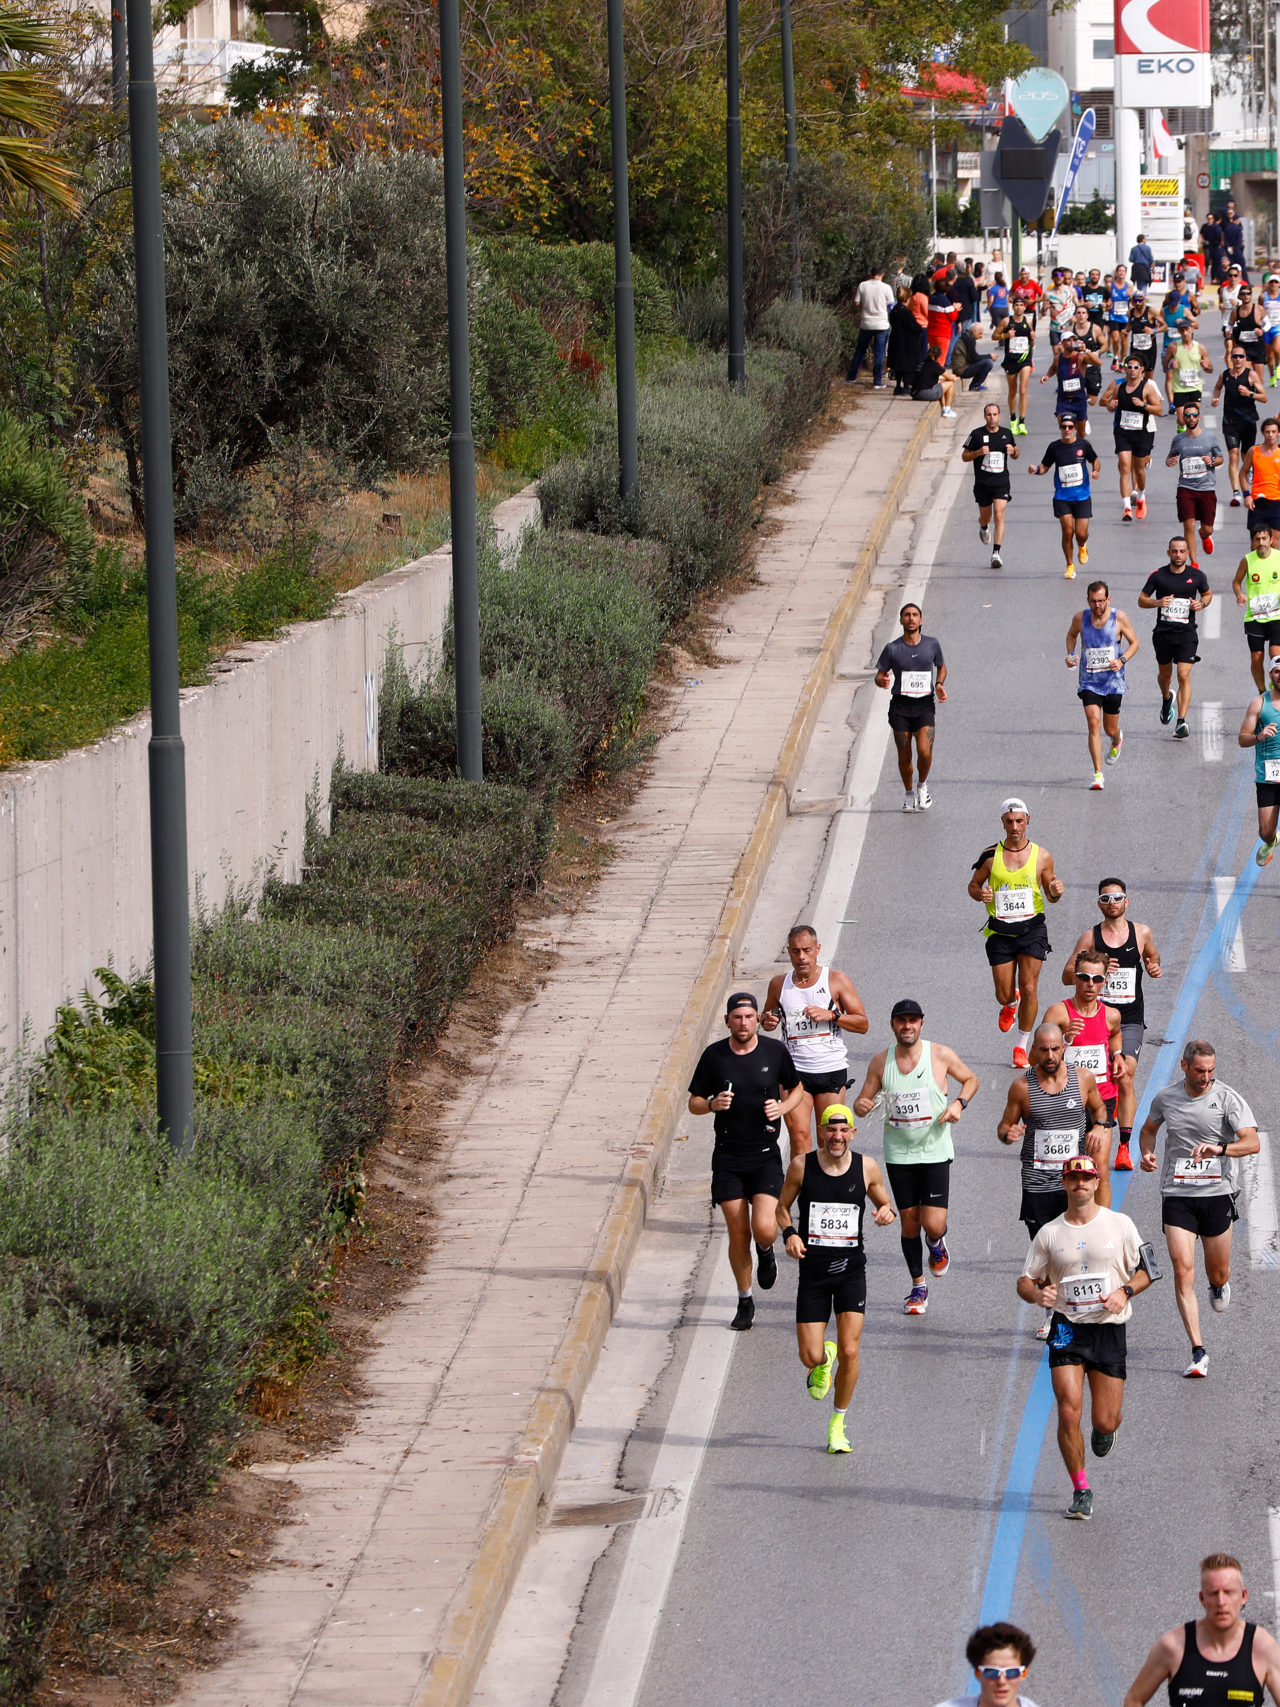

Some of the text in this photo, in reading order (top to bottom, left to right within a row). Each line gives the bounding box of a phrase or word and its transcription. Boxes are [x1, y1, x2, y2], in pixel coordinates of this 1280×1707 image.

[1137, 58, 1195, 74] EKO
[1003, 902, 1025, 911] 3644
[1105, 981, 1128, 990] 1453
[895, 1103, 920, 1114] 3391
[1043, 1144, 1071, 1155] 3686
[1184, 1159, 1211, 1170] 2417
[820, 1218, 849, 1230] 5834
[1073, 1283, 1102, 1297] 8113
